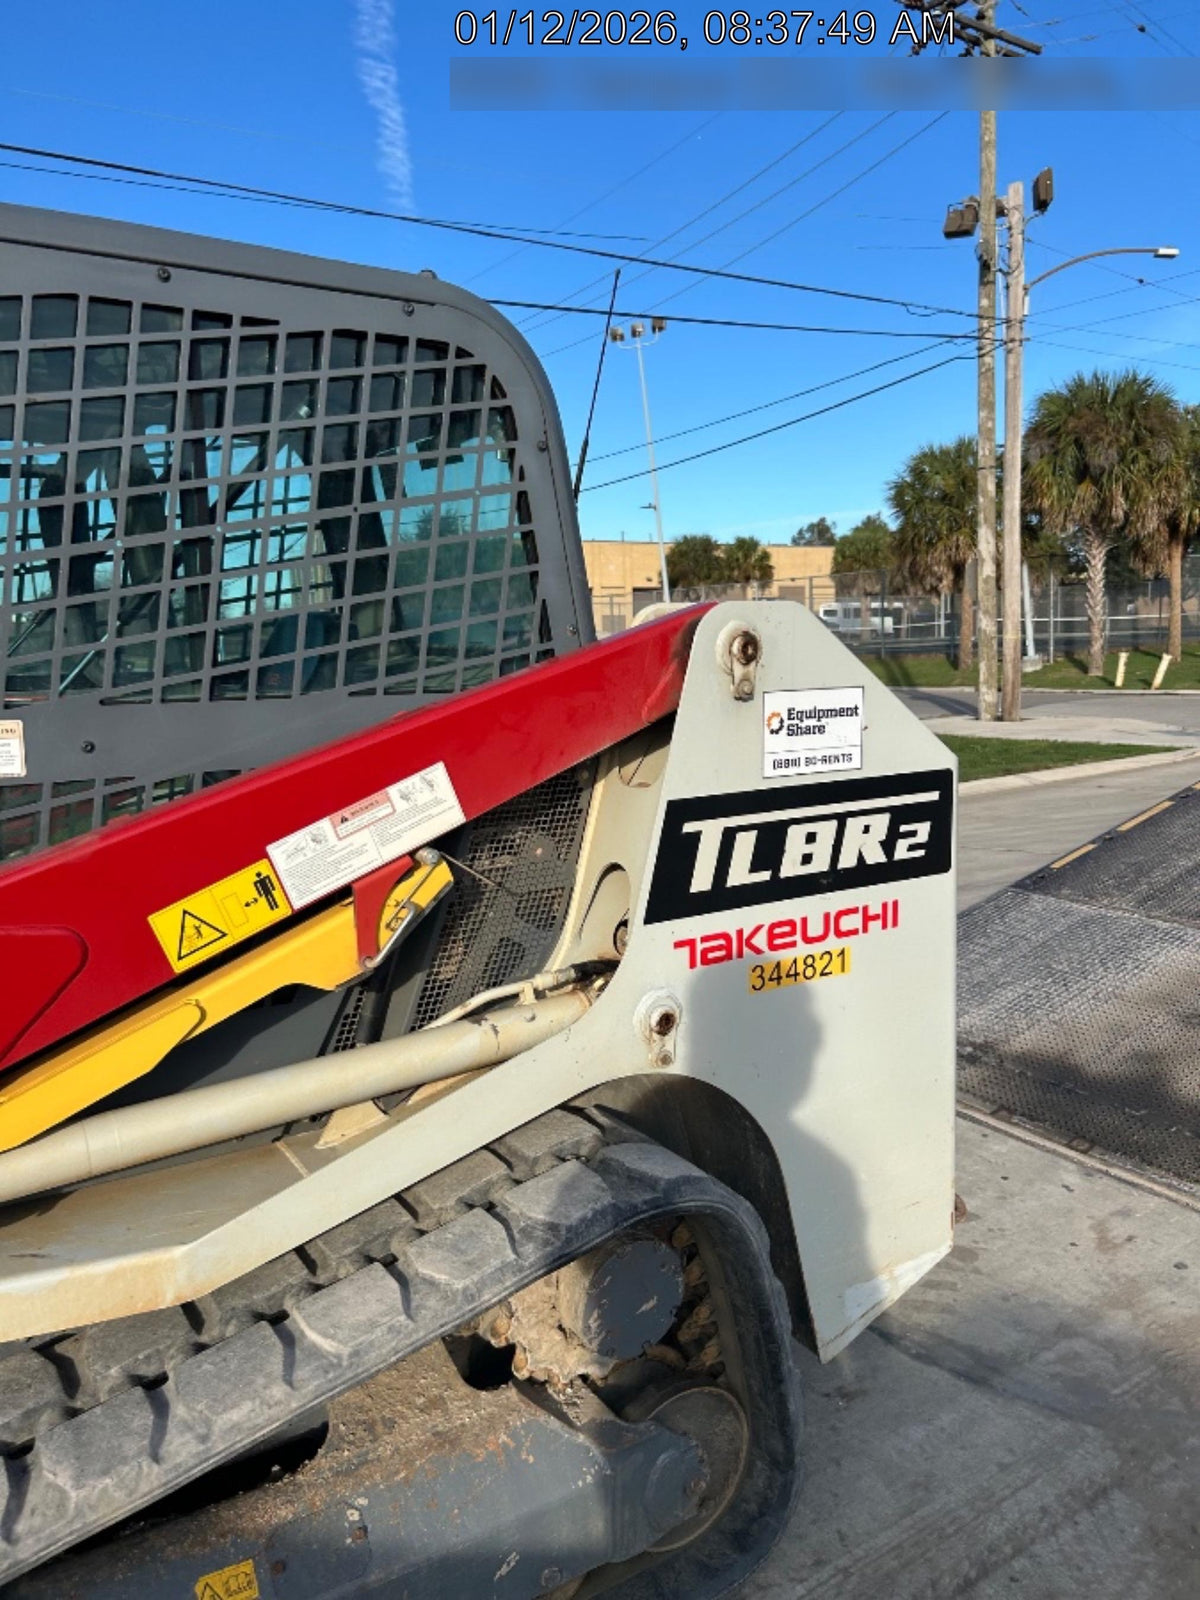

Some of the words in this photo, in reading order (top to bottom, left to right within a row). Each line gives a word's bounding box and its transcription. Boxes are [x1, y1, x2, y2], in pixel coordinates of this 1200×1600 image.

[787, 704, 860, 722] Equipment
[787, 723, 826, 737] Share
[673, 899, 899, 970] TAKEUCHI
[750, 948, 848, 992] 344821
